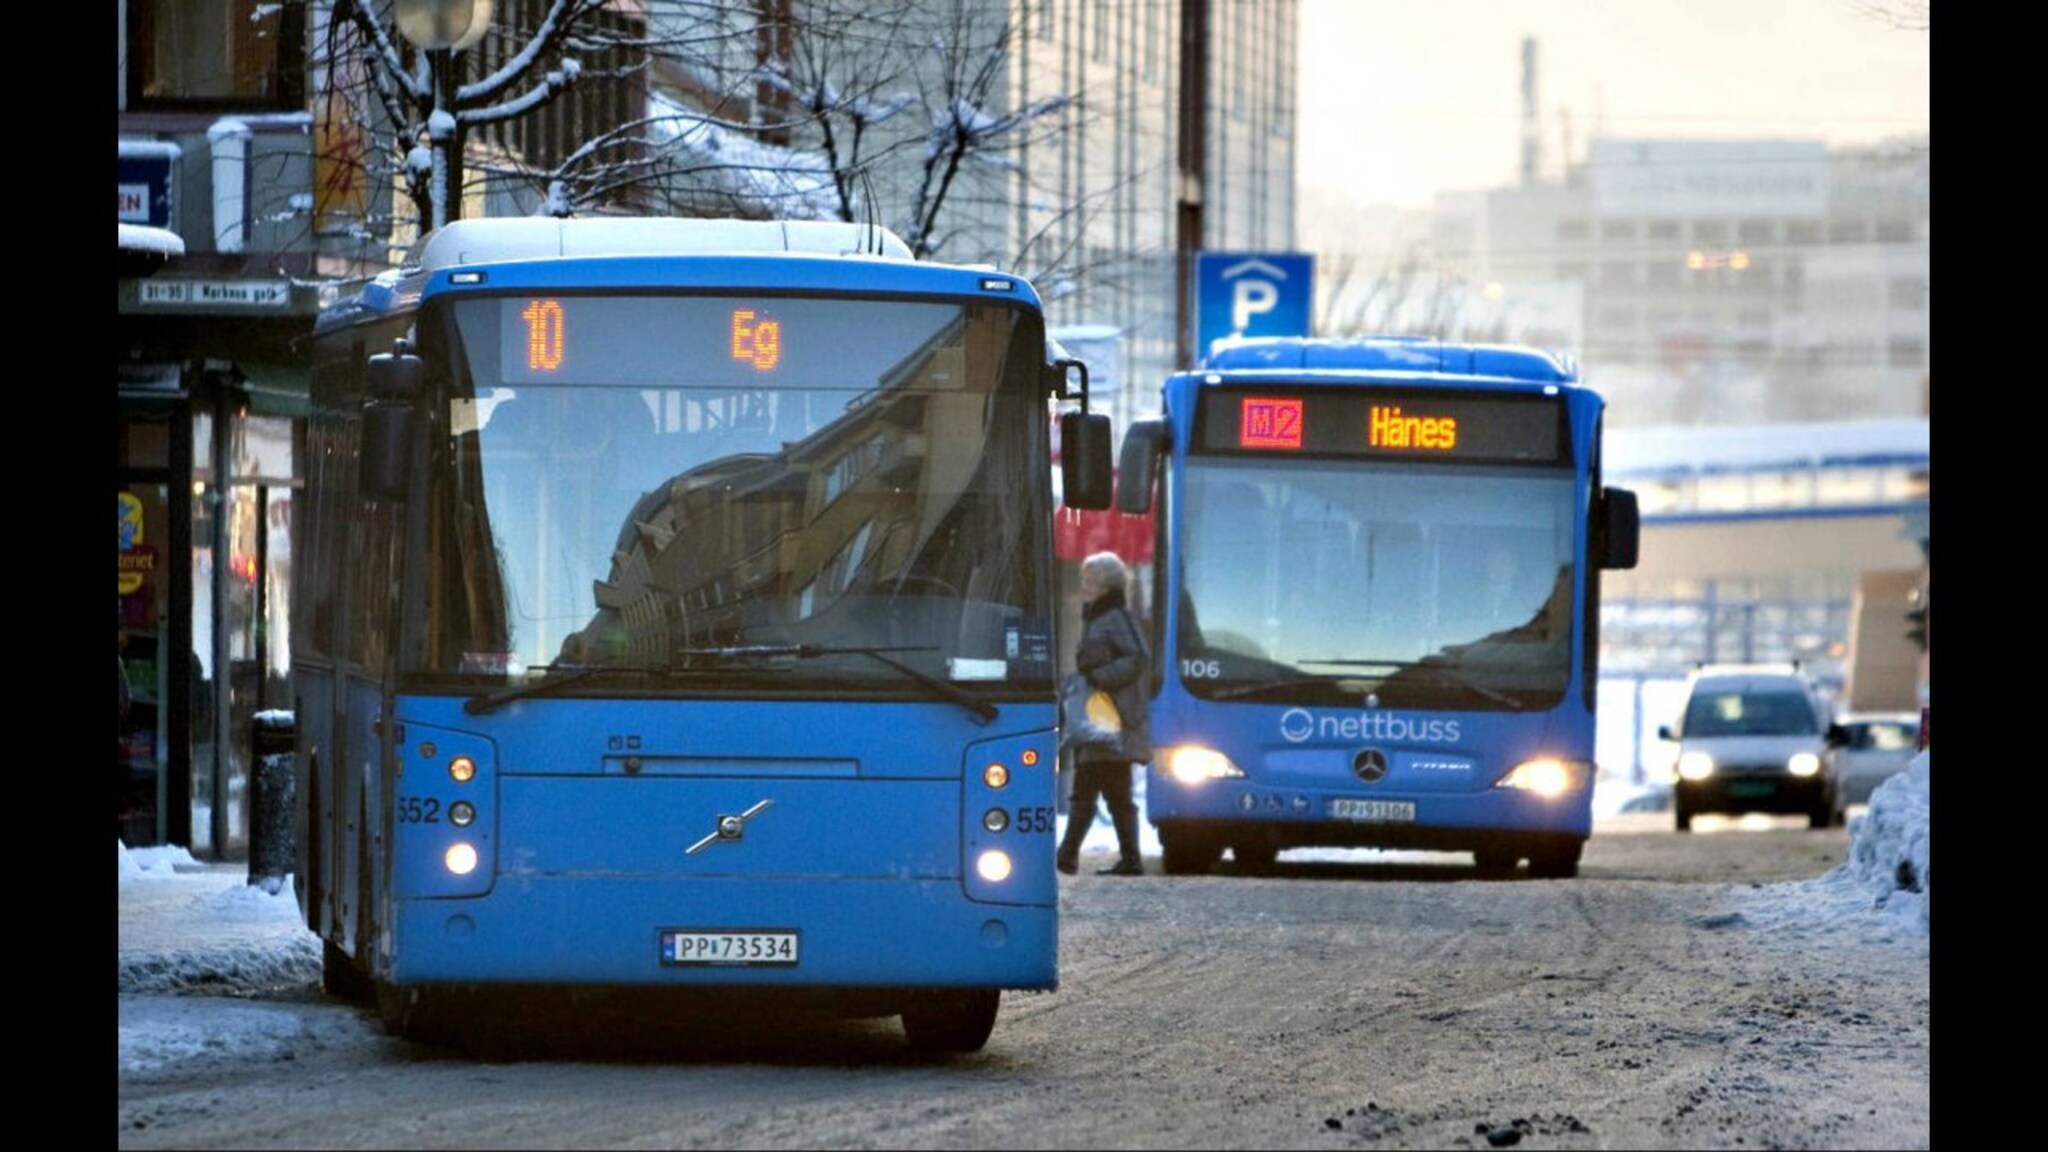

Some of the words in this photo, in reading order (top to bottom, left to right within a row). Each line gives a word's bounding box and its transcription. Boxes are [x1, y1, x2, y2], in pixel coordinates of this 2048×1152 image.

[1233, 279, 1278, 329] P
[523, 299, 564, 370] 10
[731, 310, 779, 370] Eg
[1248, 404, 1299, 439] M2
[1370, 405, 1455, 448] Hånes
[1182, 659, 1220, 678] 106
[1320, 711, 1460, 742] nettbuss
[721, 937, 792, 958] 73534
